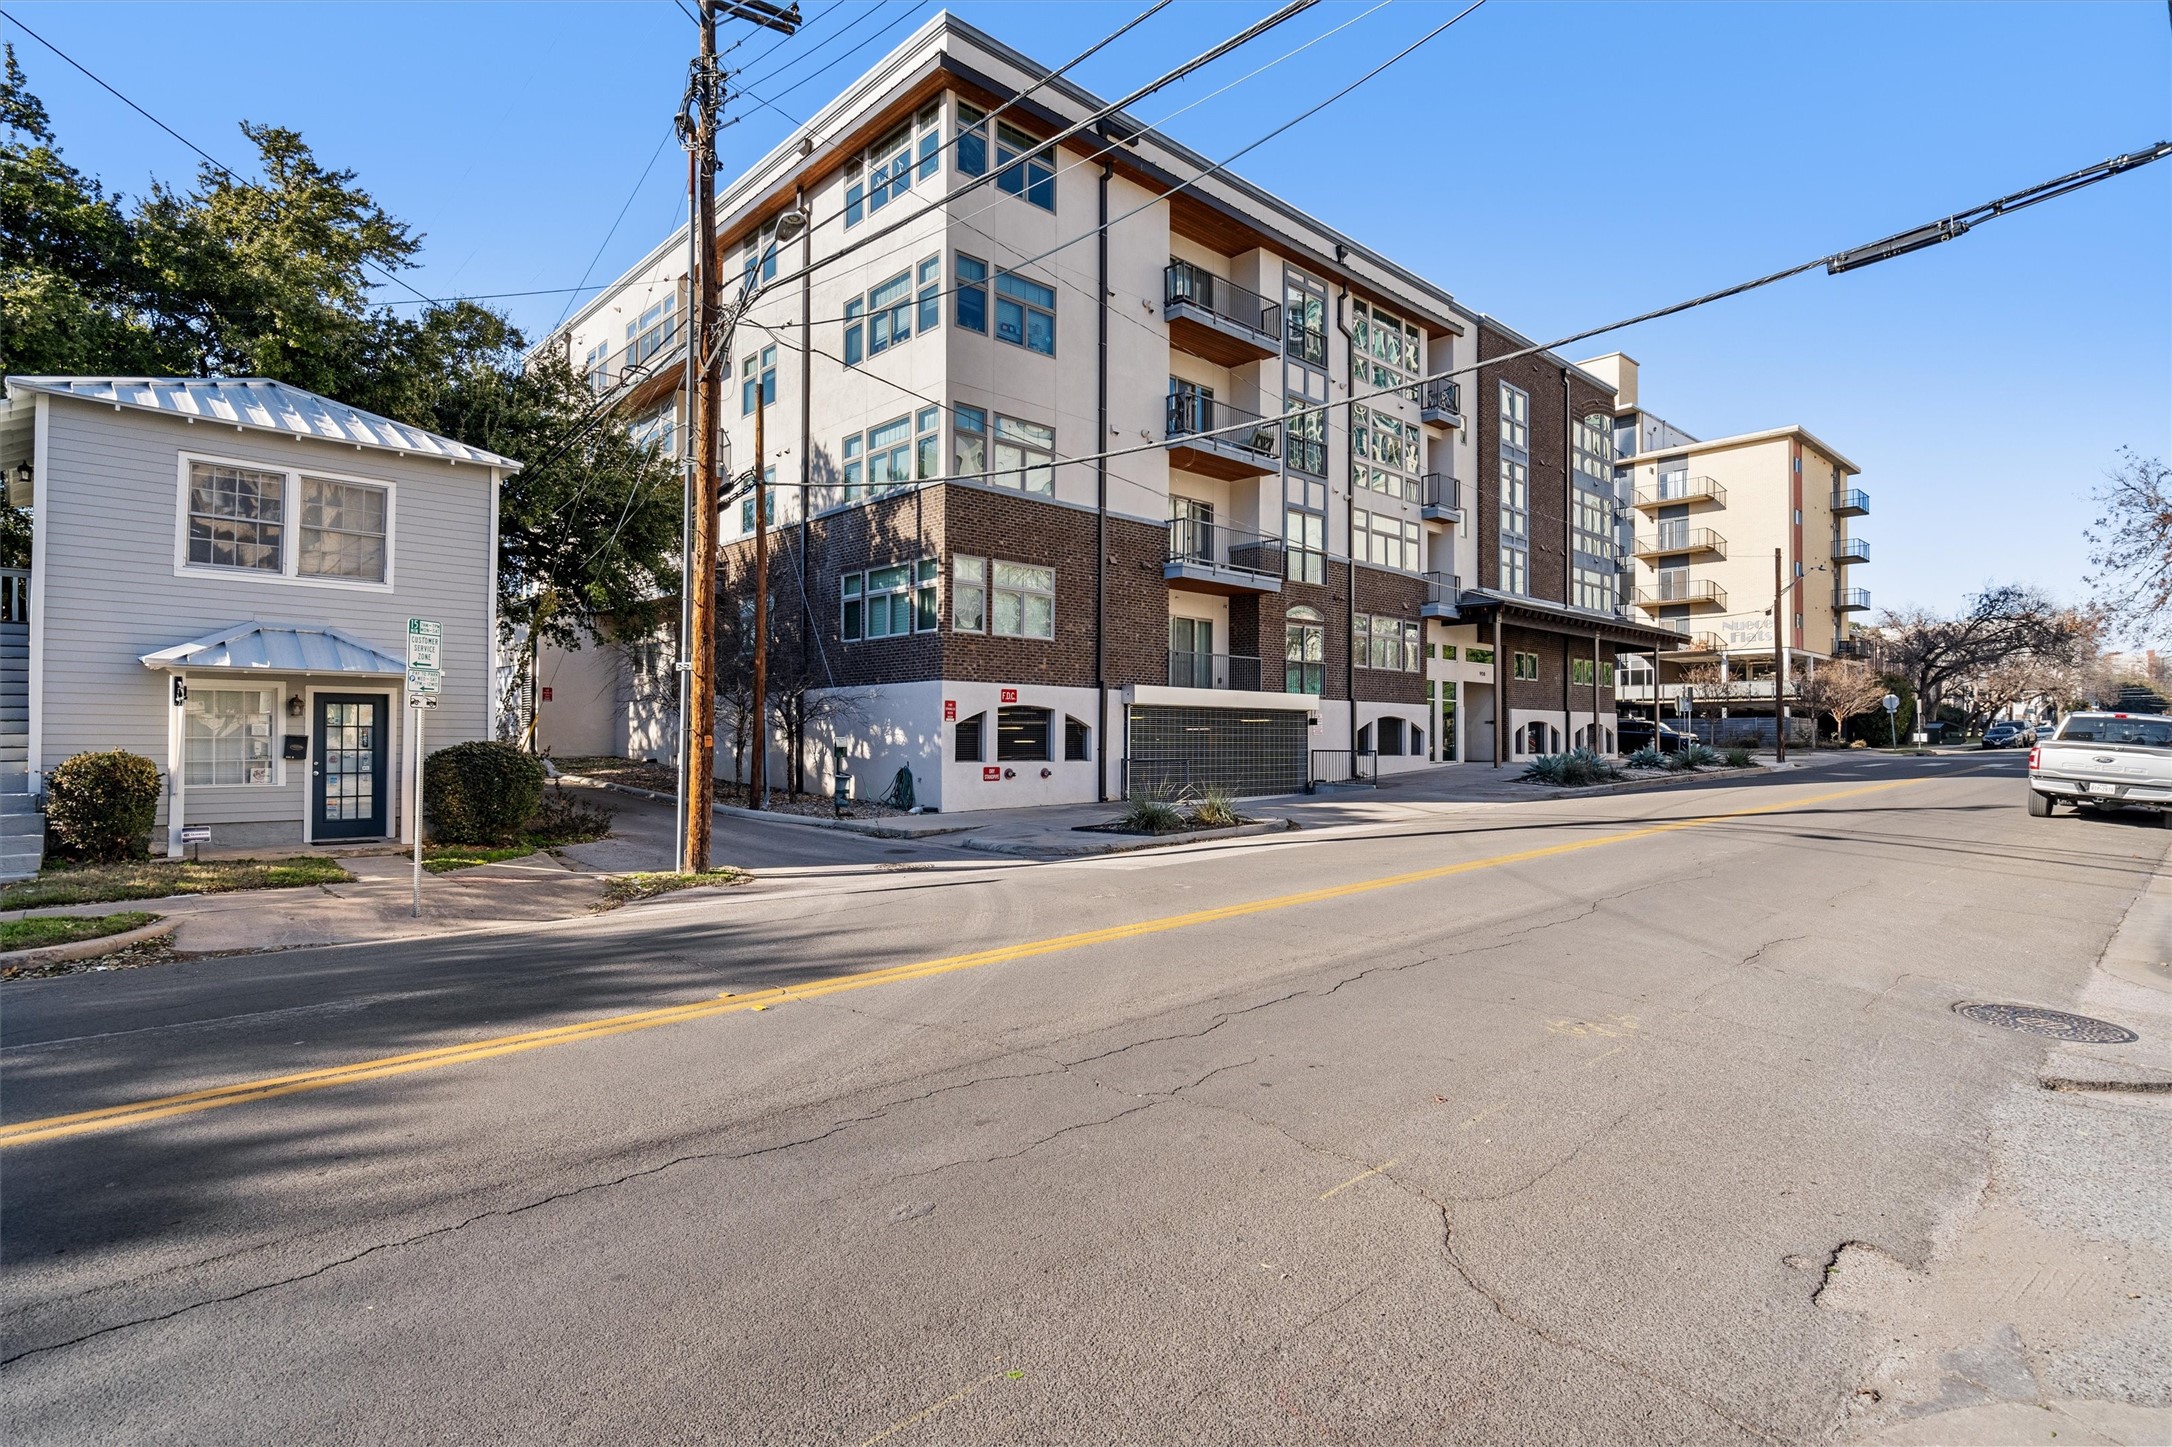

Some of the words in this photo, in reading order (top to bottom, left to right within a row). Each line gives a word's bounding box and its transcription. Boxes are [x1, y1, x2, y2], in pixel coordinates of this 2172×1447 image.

[411, 619, 418, 629] 15
[411, 635, 438, 645] CUSTOMER
[1731, 631, 1773, 643] Flats
[414, 644, 435, 653] SERVICE
[417, 653, 431, 661] ZONE
